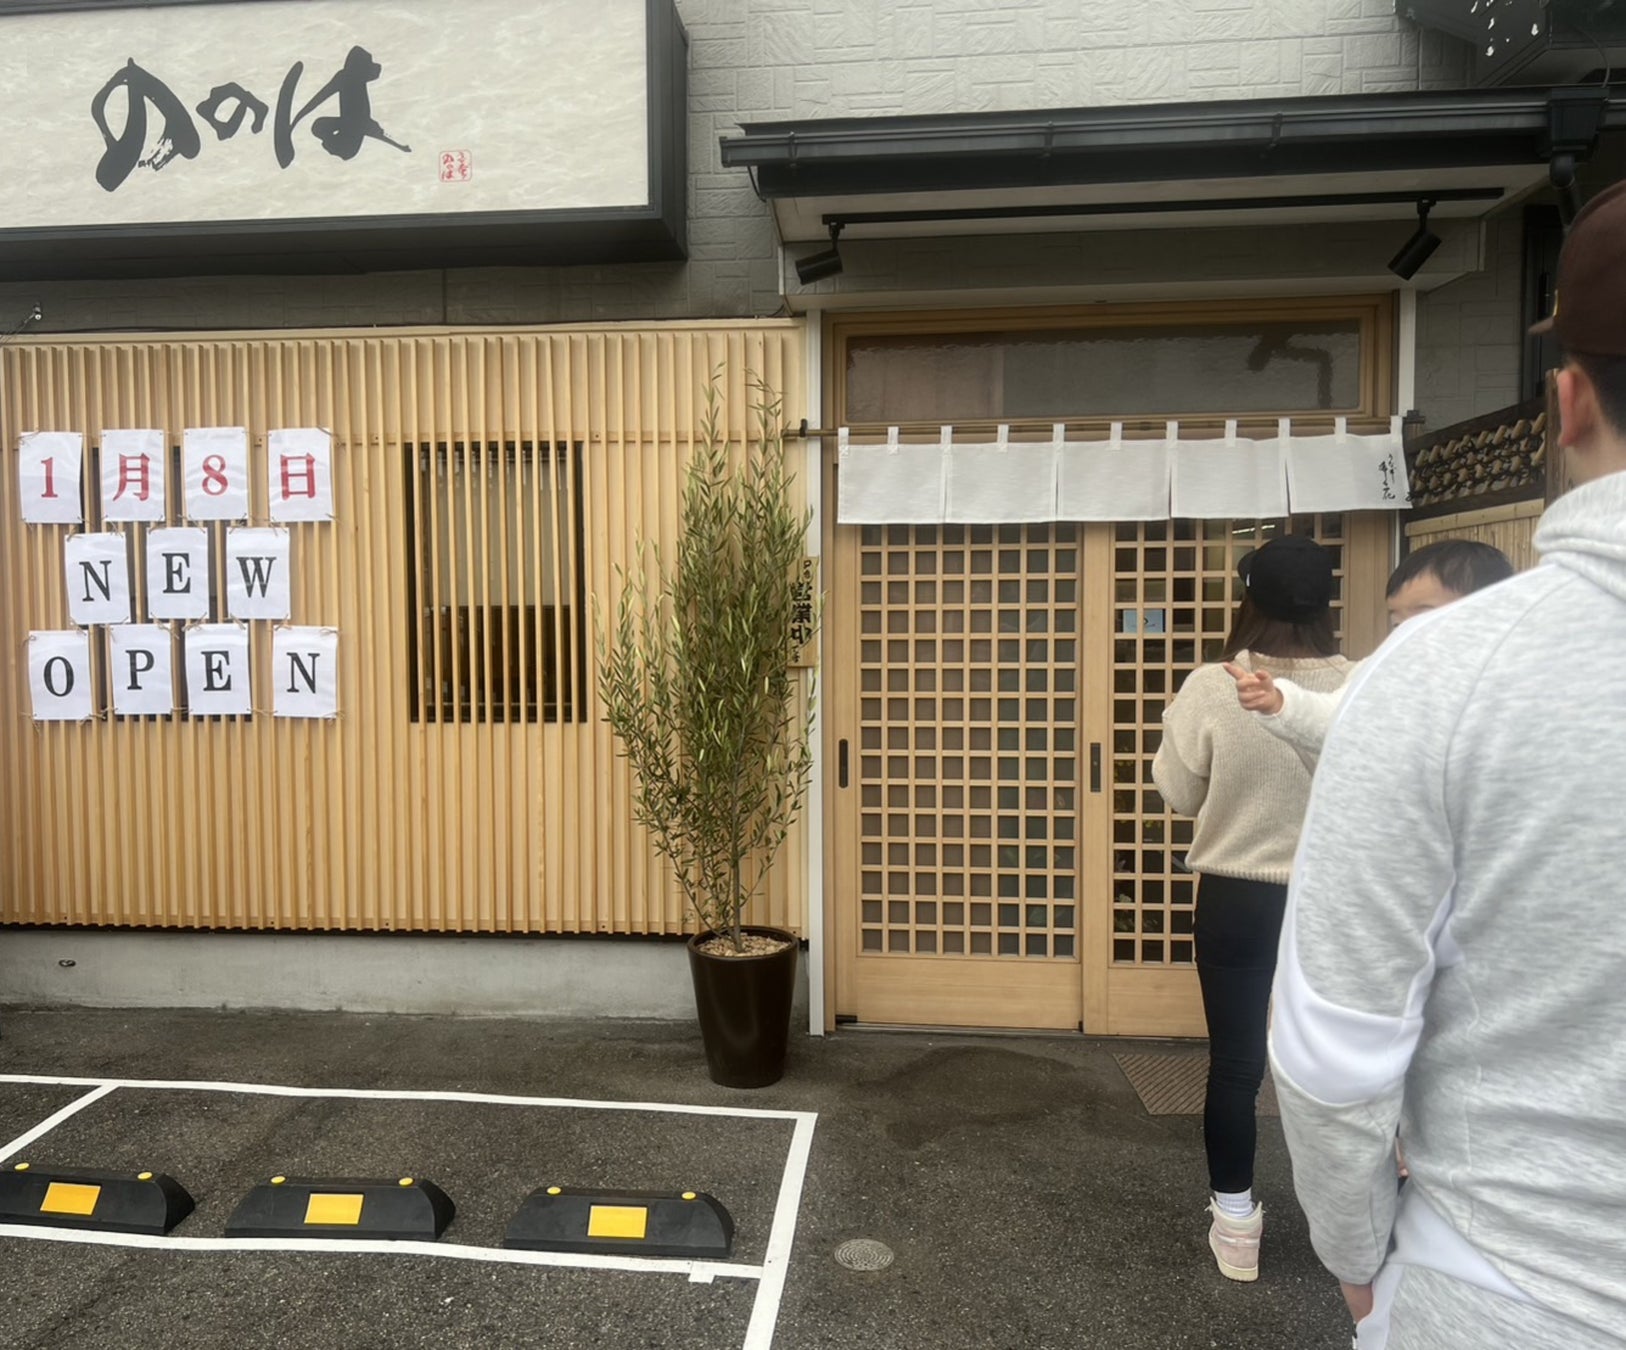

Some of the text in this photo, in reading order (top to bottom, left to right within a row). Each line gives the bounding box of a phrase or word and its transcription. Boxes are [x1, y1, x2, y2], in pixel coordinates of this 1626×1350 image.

[91, 45, 412, 192] ののは
[41, 453, 317, 501] 1月8日
[79, 551, 277, 603] NEW
[43, 649, 321, 697] OPEN
